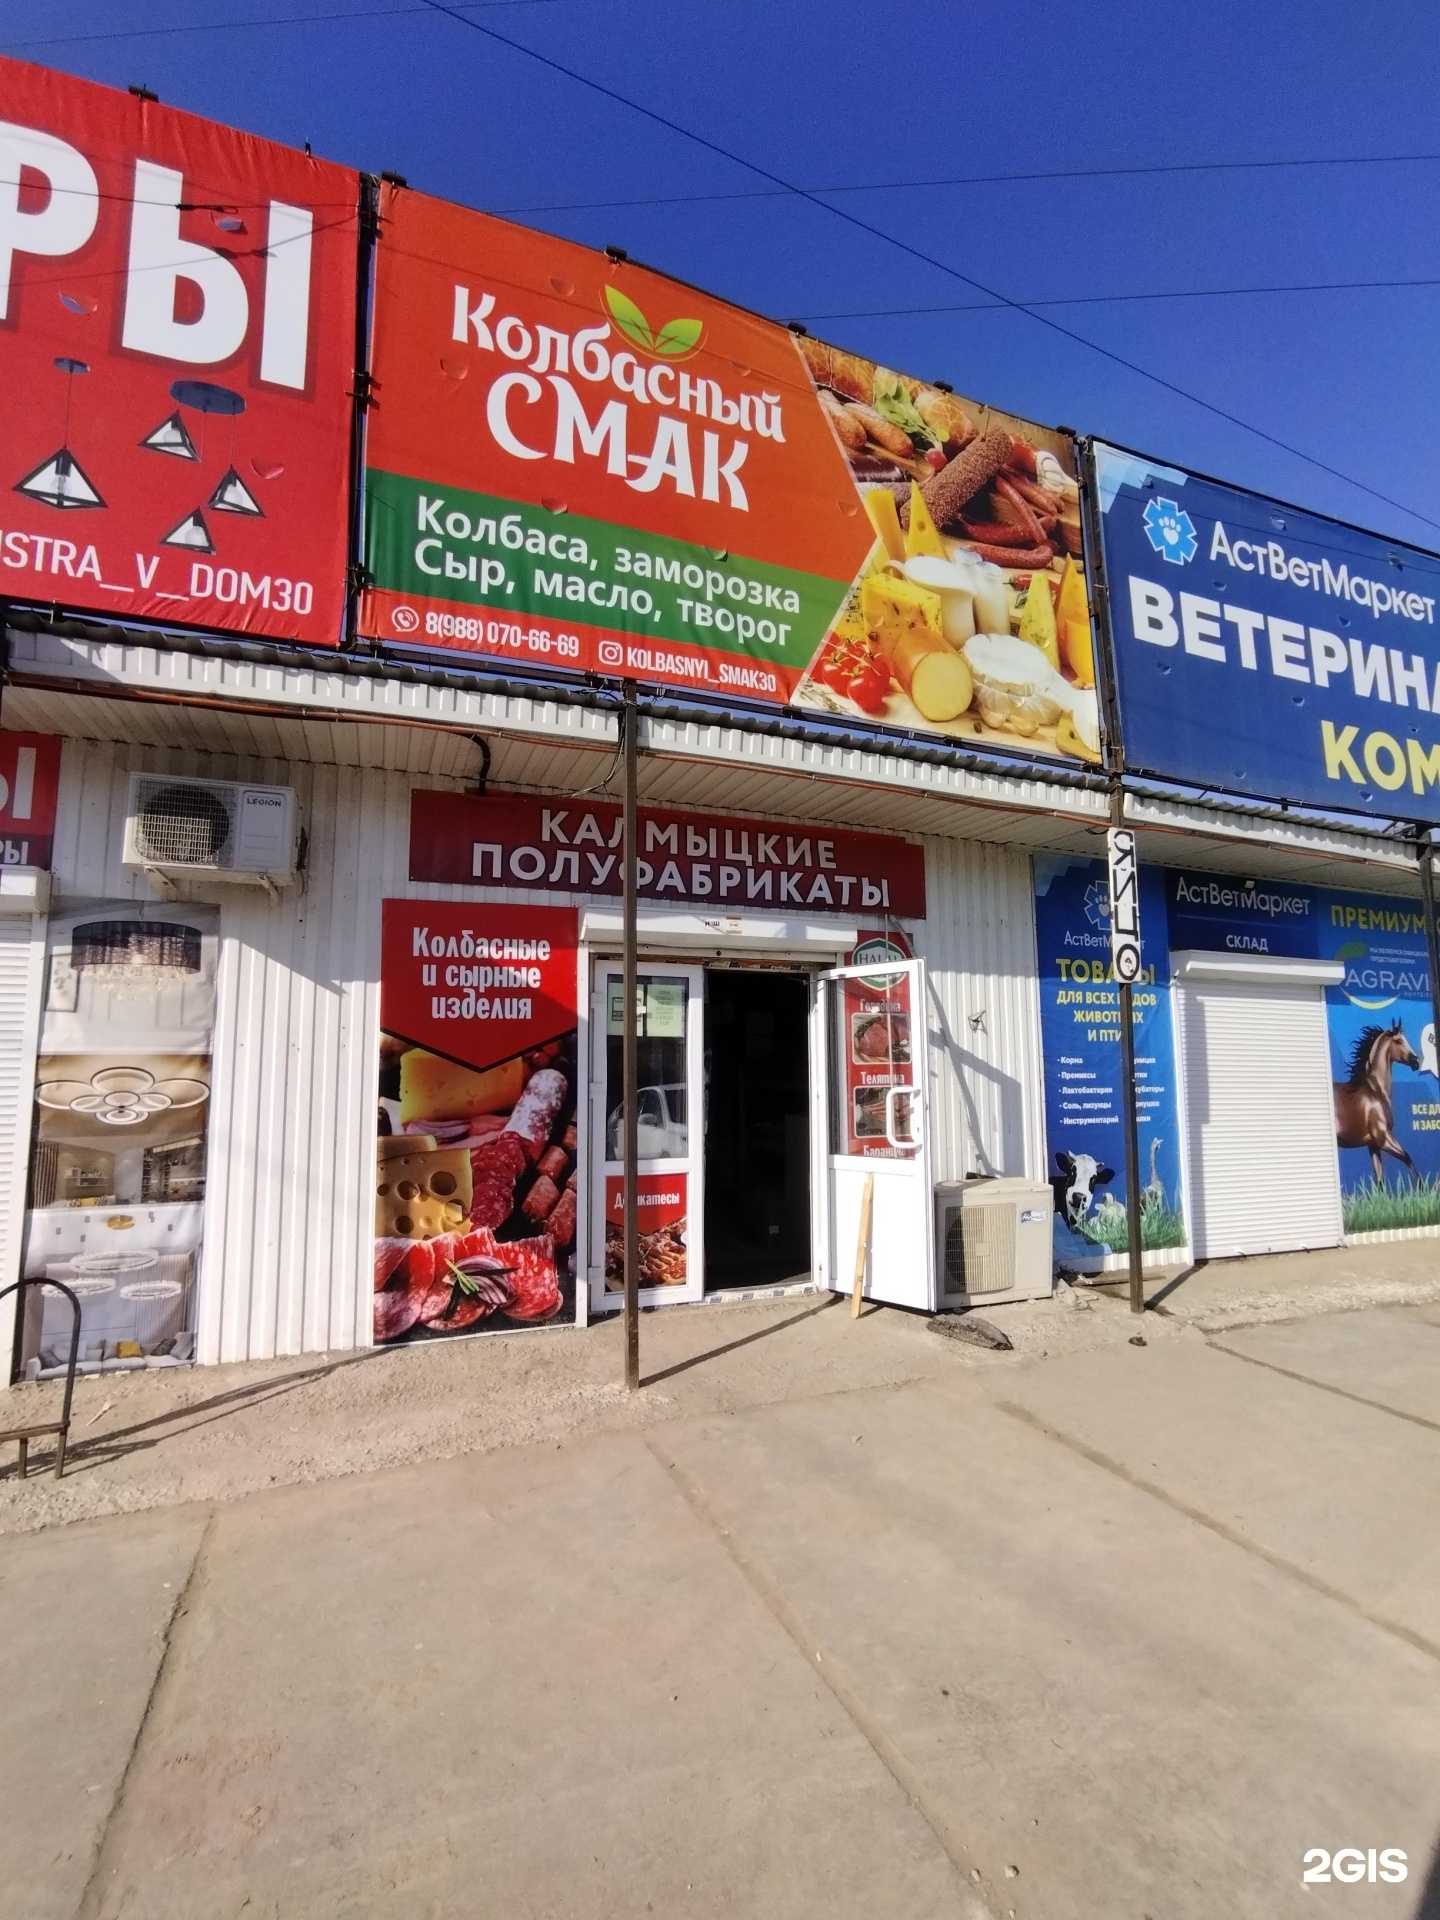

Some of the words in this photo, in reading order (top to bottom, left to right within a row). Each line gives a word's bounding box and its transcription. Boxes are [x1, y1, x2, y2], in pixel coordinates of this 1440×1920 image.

[451, 285, 786, 443] Колбасный
[486, 372, 750, 512] СМАК
[416, 495, 598, 571] Колбаса,
[614, 546, 801, 614] заморозка
[1209, 520, 1436, 625] АстВетМаркет
[413, 539, 515, 595] Сыр,
[533, 568, 662, 622] масло,
[676, 597, 792, 646] творог
[425, 612, 484, 643] 8(988)
[487, 621, 580, 657] 070-66-69
[627, 647, 777, 692] KOLBASNYI_SMAK30
[1321, 720, 1440, 796] КОМ
[471, 842, 890, 909] ПОЛУФАБРИКАТЫ
[1176, 875, 1312, 918] АстВетМаркет
[412, 927, 551, 961] Колбасные
[1064, 930, 1147, 950] АстВетМт
[1225, 934, 1269, 953] СКЛАД
[422, 964, 437, 987] и
[445, 964, 542, 993] сырные
[1056, 958, 1155, 985] ТОВЫ
[431, 987, 532, 1019] изделия
[1056, 990, 1083, 1005] ДЛЯ
[1085, 991, 1115, 1005] ВСЕХ
[1117, 993, 1157, 1006] ДОВ
[1073, 1009, 1144, 1024] ЖИВОТХ
[1088, 1029, 1098, 1042] И
[1100, 1029, 1122, 1042] ПТИ
[1411, 1103, 1427, 1116] ВСЕ
